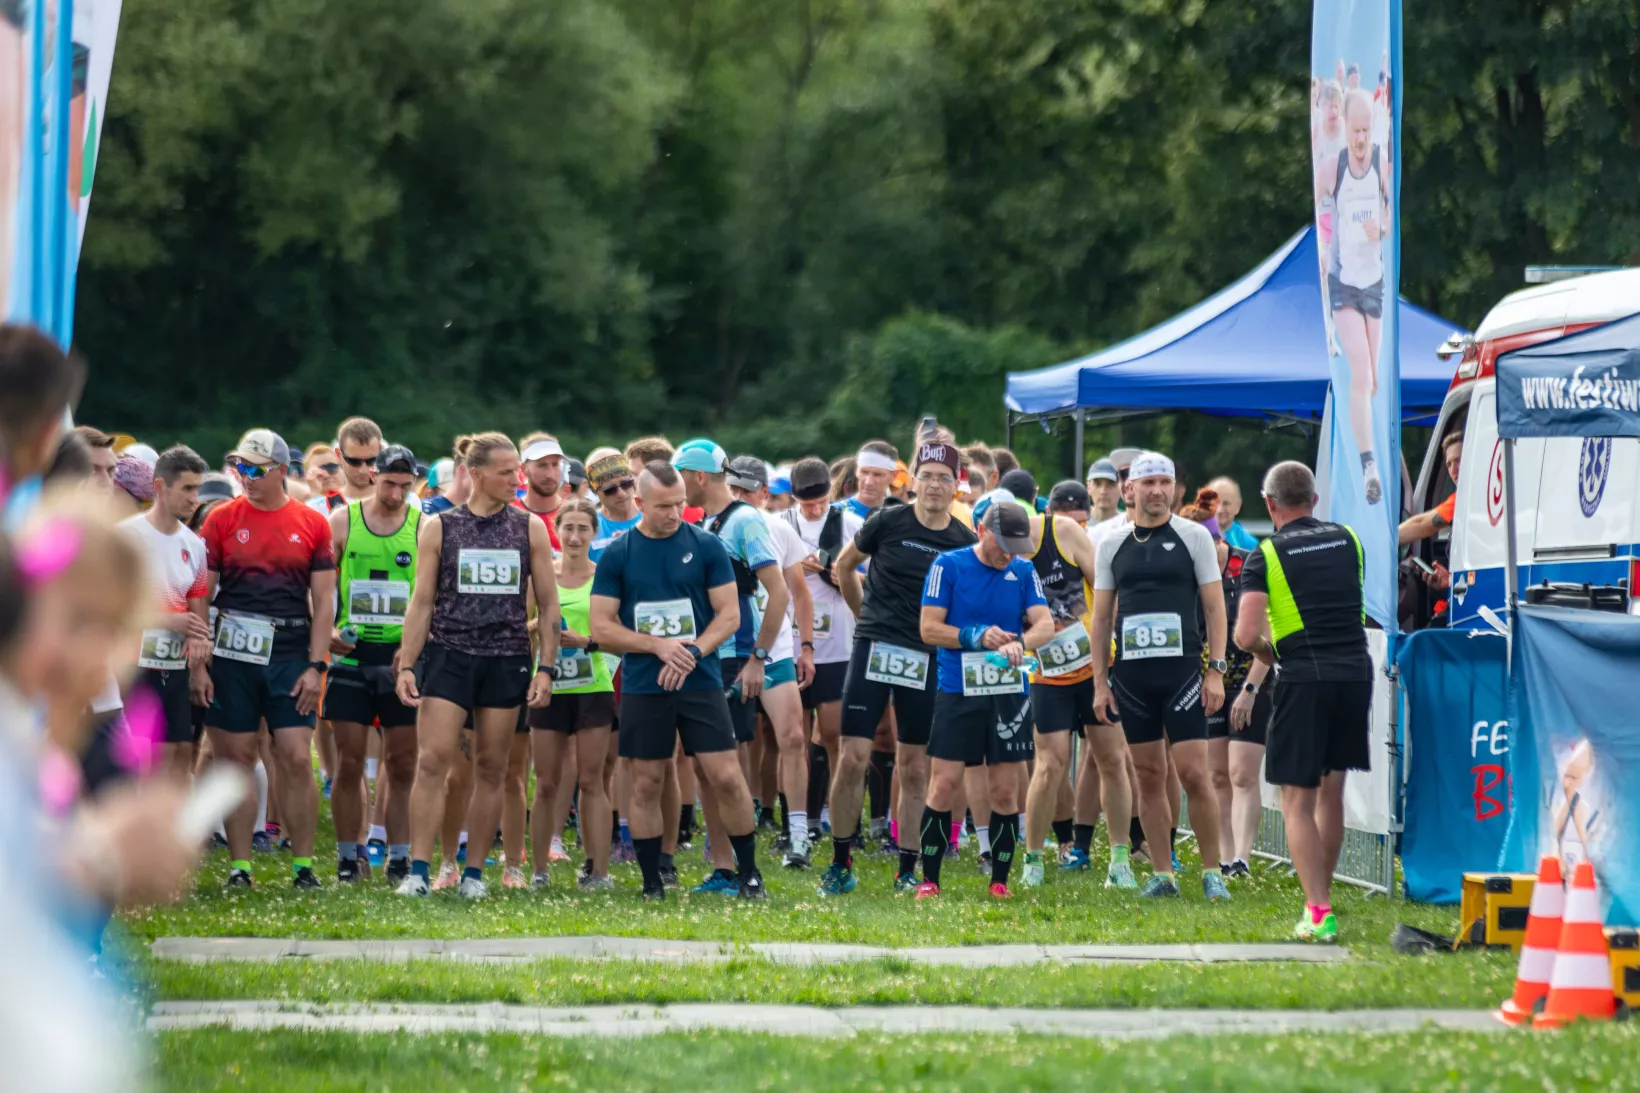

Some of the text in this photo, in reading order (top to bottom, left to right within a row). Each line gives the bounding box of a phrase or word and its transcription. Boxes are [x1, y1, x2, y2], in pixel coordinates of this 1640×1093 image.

[1521, 365, 1640, 413] www.festiw
[469, 561, 512, 584] 159
[370, 592, 391, 614] 11
[649, 614, 682, 636] 23
[156, 637, 181, 659] 50
[224, 626, 264, 653] 160
[1135, 626, 1167, 648] 85
[1050, 640, 1080, 664] 89
[879, 652, 920, 679] 152
[972, 663, 1015, 686] 162
[1007, 742, 1034, 751] NIKE
